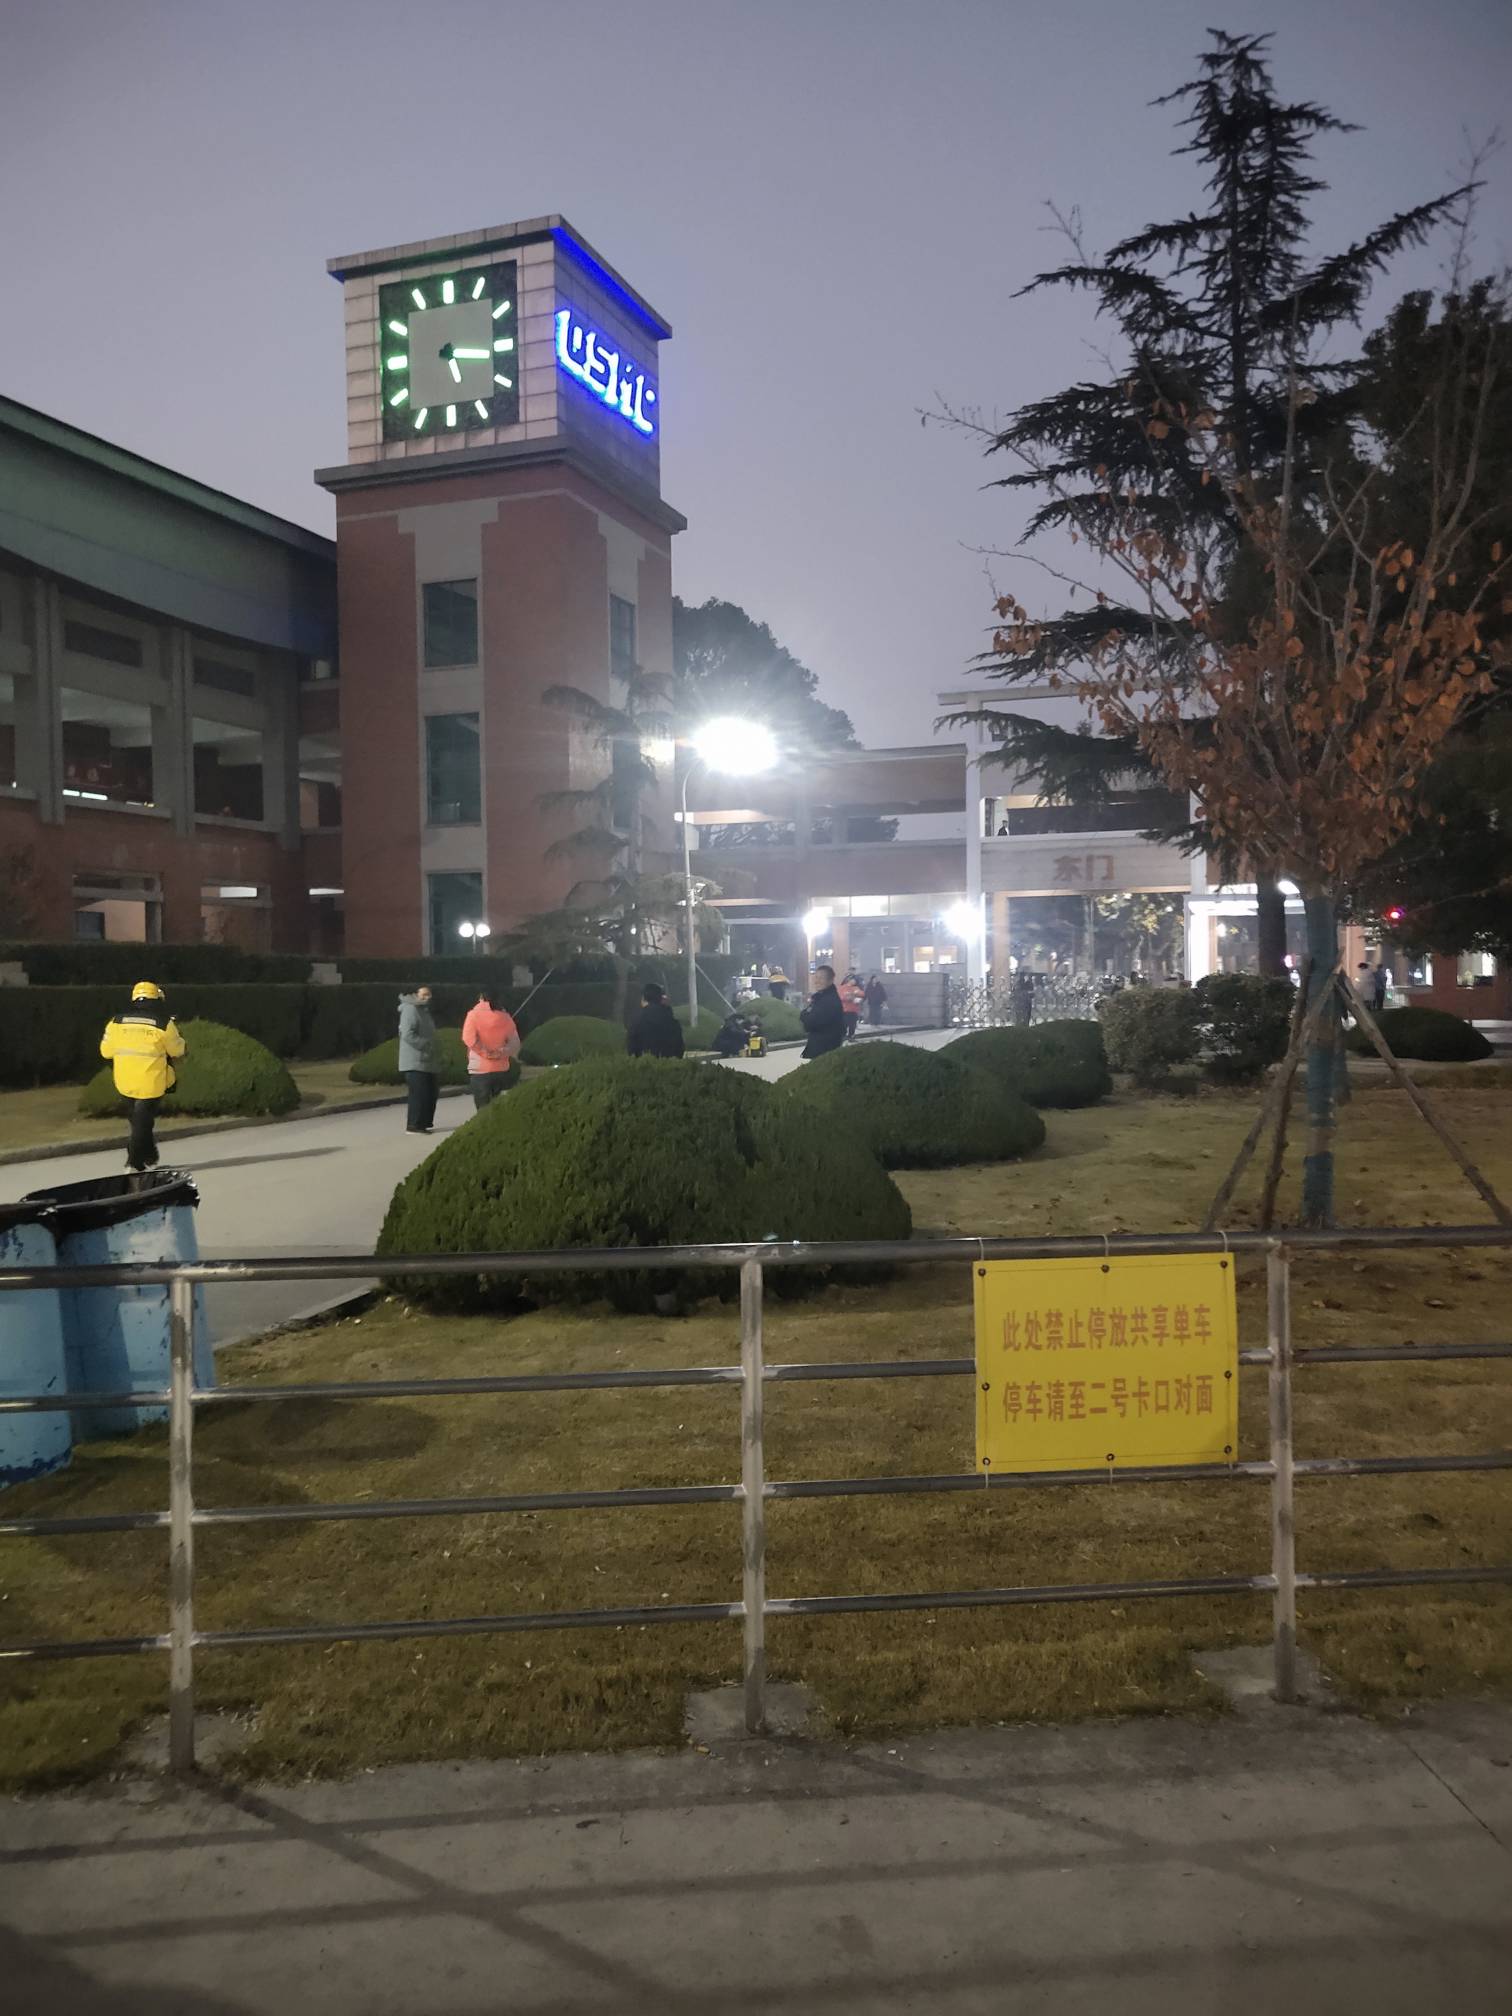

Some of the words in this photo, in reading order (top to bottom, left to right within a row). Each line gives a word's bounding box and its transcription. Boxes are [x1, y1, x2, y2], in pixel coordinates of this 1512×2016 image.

[1053, 855, 1115, 881] 东门
[1002, 1303, 1213, 1352] 此处禁止停放共享单车
[1002, 1374, 1214, 1423] 停车请至二号卡口对面
